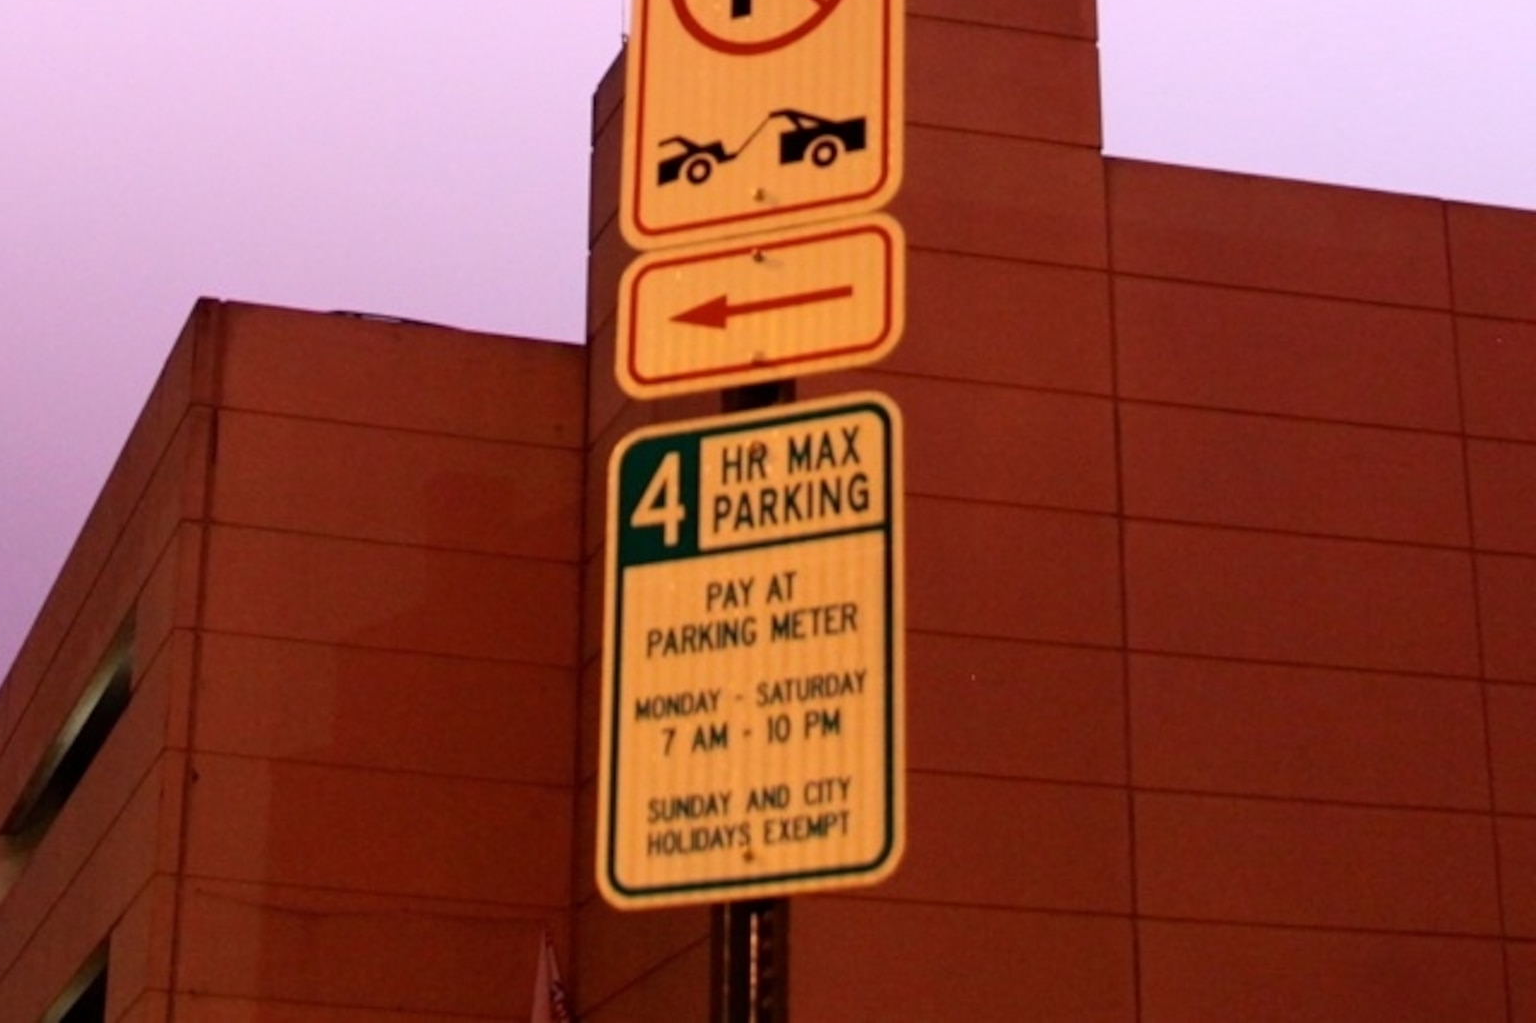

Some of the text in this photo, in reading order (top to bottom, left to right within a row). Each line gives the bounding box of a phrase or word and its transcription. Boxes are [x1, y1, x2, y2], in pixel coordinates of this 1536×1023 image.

[721, 425, 860, 485] HR MAX
[630, 451, 686, 547] 4
[713, 473, 869, 532] PARKING
[706, 571, 797, 611] PAY AT
[646, 603, 857, 659] PARKING METER
[635, 689, 720, 721] MONDAY
[756, 669, 867, 707] SATURDAY
[662, 729, 676, 756] 7
[691, 723, 728, 753] AM
[767, 714, 790, 744] 10
[804, 708, 842, 739] PM
[647, 776, 851, 824] SUNDAY AND CITY
[646, 810, 850, 857] HOLIDAYS EXEMPT
